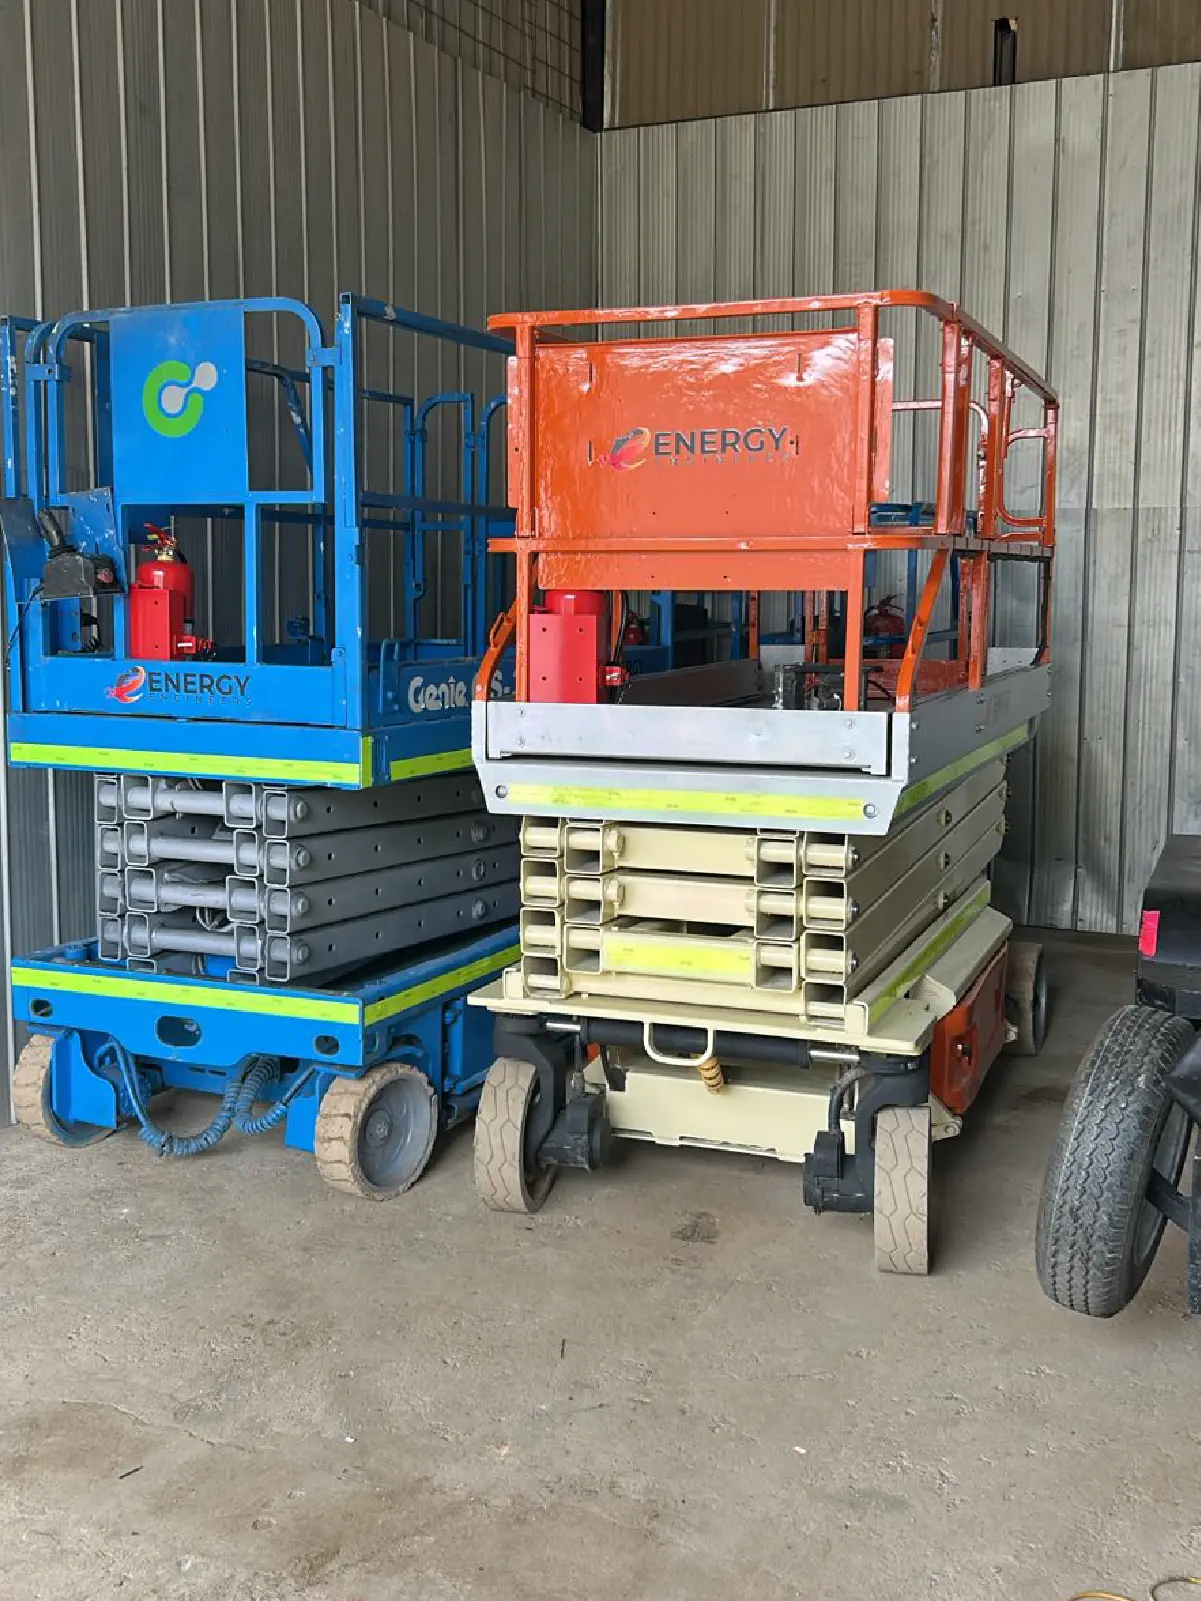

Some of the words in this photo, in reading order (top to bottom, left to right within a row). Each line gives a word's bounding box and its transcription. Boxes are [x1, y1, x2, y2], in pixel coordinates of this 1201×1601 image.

[654, 427, 788, 456] ENERGY
[147, 672, 250, 697] ENERGY
[408, 676, 468, 712] Genie
